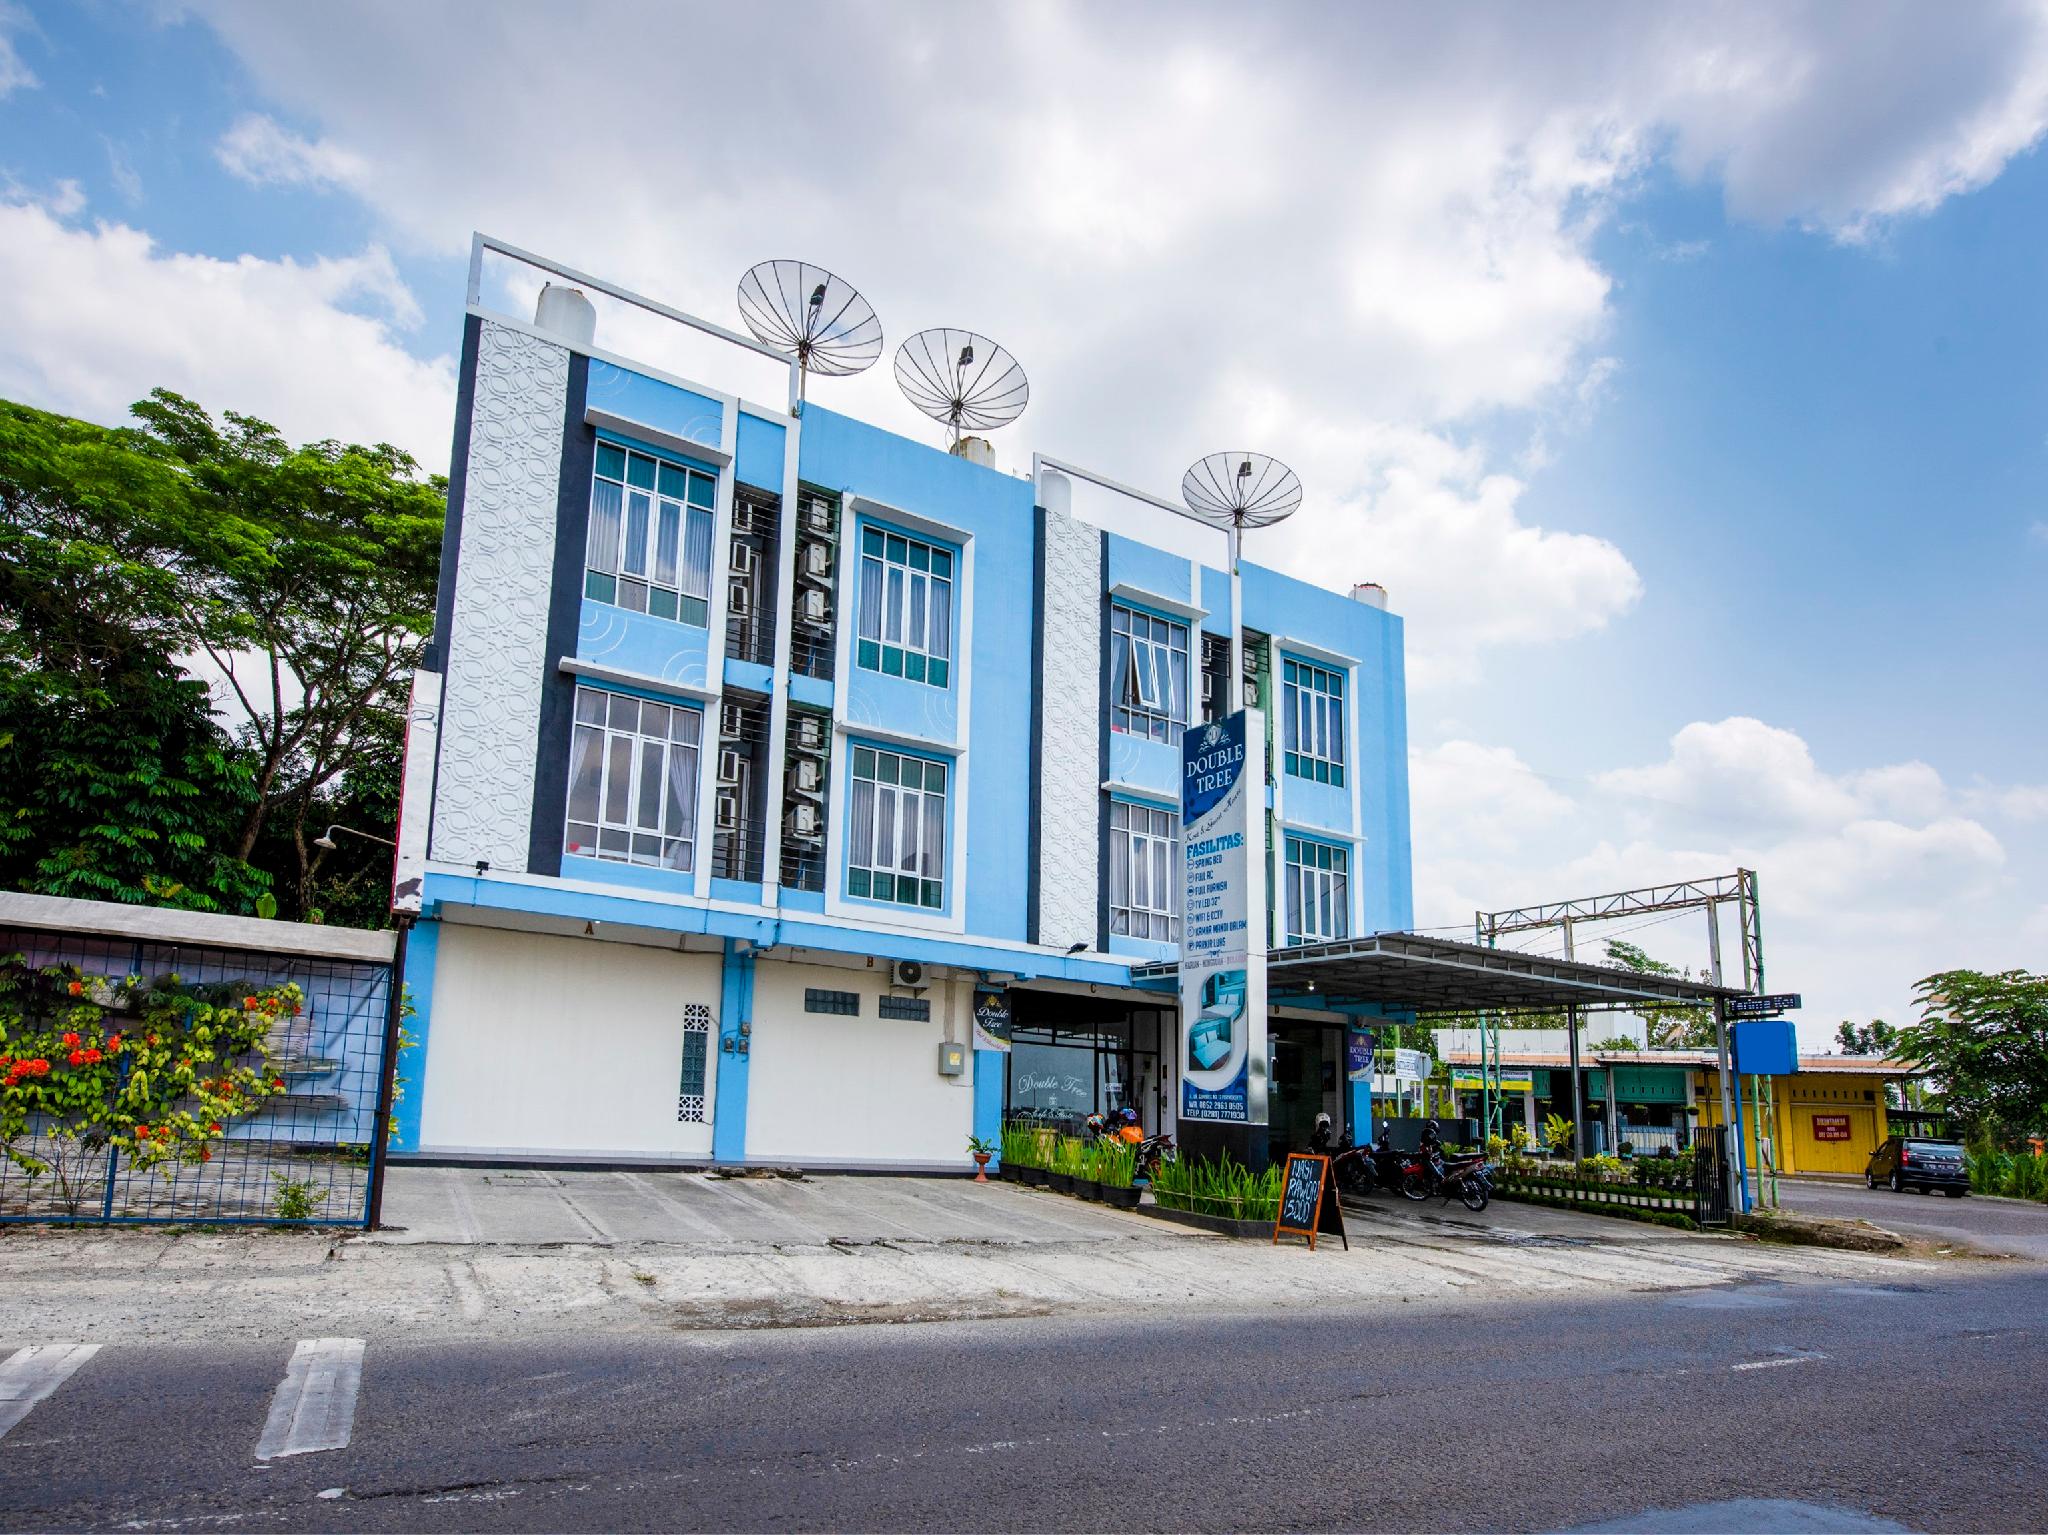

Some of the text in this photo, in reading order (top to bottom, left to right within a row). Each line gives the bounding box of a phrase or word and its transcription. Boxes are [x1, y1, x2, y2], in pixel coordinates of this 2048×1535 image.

[1187, 744, 1243, 778] DOUBLE
[1197, 769, 1233, 794] TREE
[1186, 833, 1244, 859] FASILITAS:
[1195, 855, 1223, 869] SPRING BED
[1195, 872, 1206, 882] FULL
[1195, 886, 1206, 896] FULL
[1195, 900, 1201, 909] TV
[1202, 898, 1211, 908] LED
[584, 921, 594, 935] A
[977, 1006, 1009, 1019] Double
[982, 1017, 1003, 1028] Tree
[1349, 1046, 1373, 1056] DOUBLE
[1354, 1055, 1369, 1063] TREE
[1018, 1072, 1058, 1094] Double
[1061, 1075, 1088, 1097] Tree
